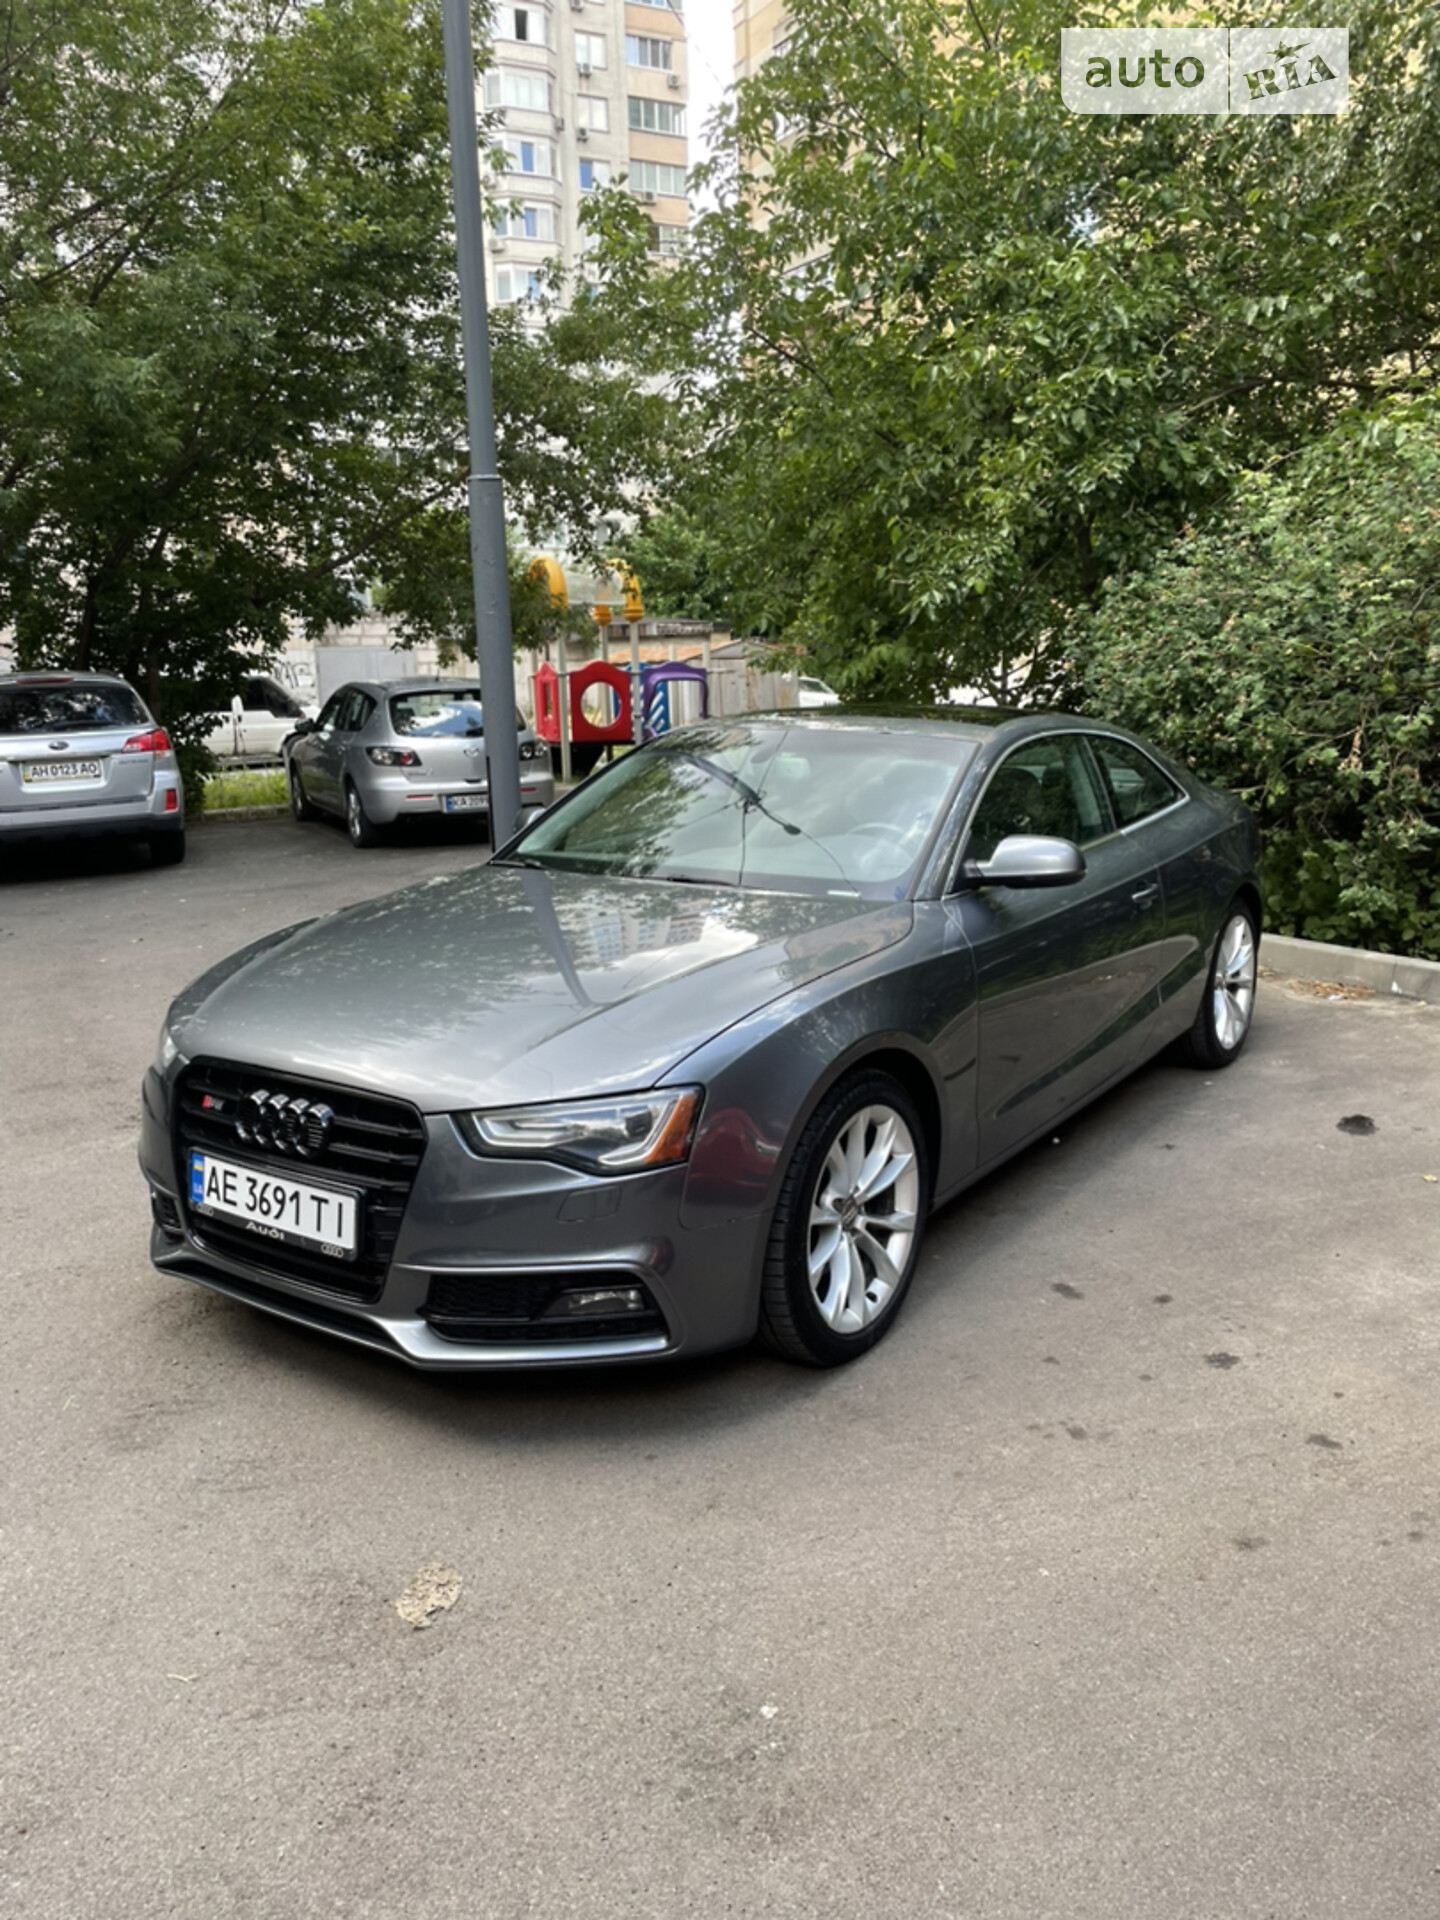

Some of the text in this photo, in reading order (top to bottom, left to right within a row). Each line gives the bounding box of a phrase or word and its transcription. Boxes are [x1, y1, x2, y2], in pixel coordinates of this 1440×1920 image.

[31, 766, 48, 778] AH
[51, 764, 78, 776] 0123
[206, 1166, 343, 1238] AE 3691 TI
[245, 1221, 286, 1241] Audi
